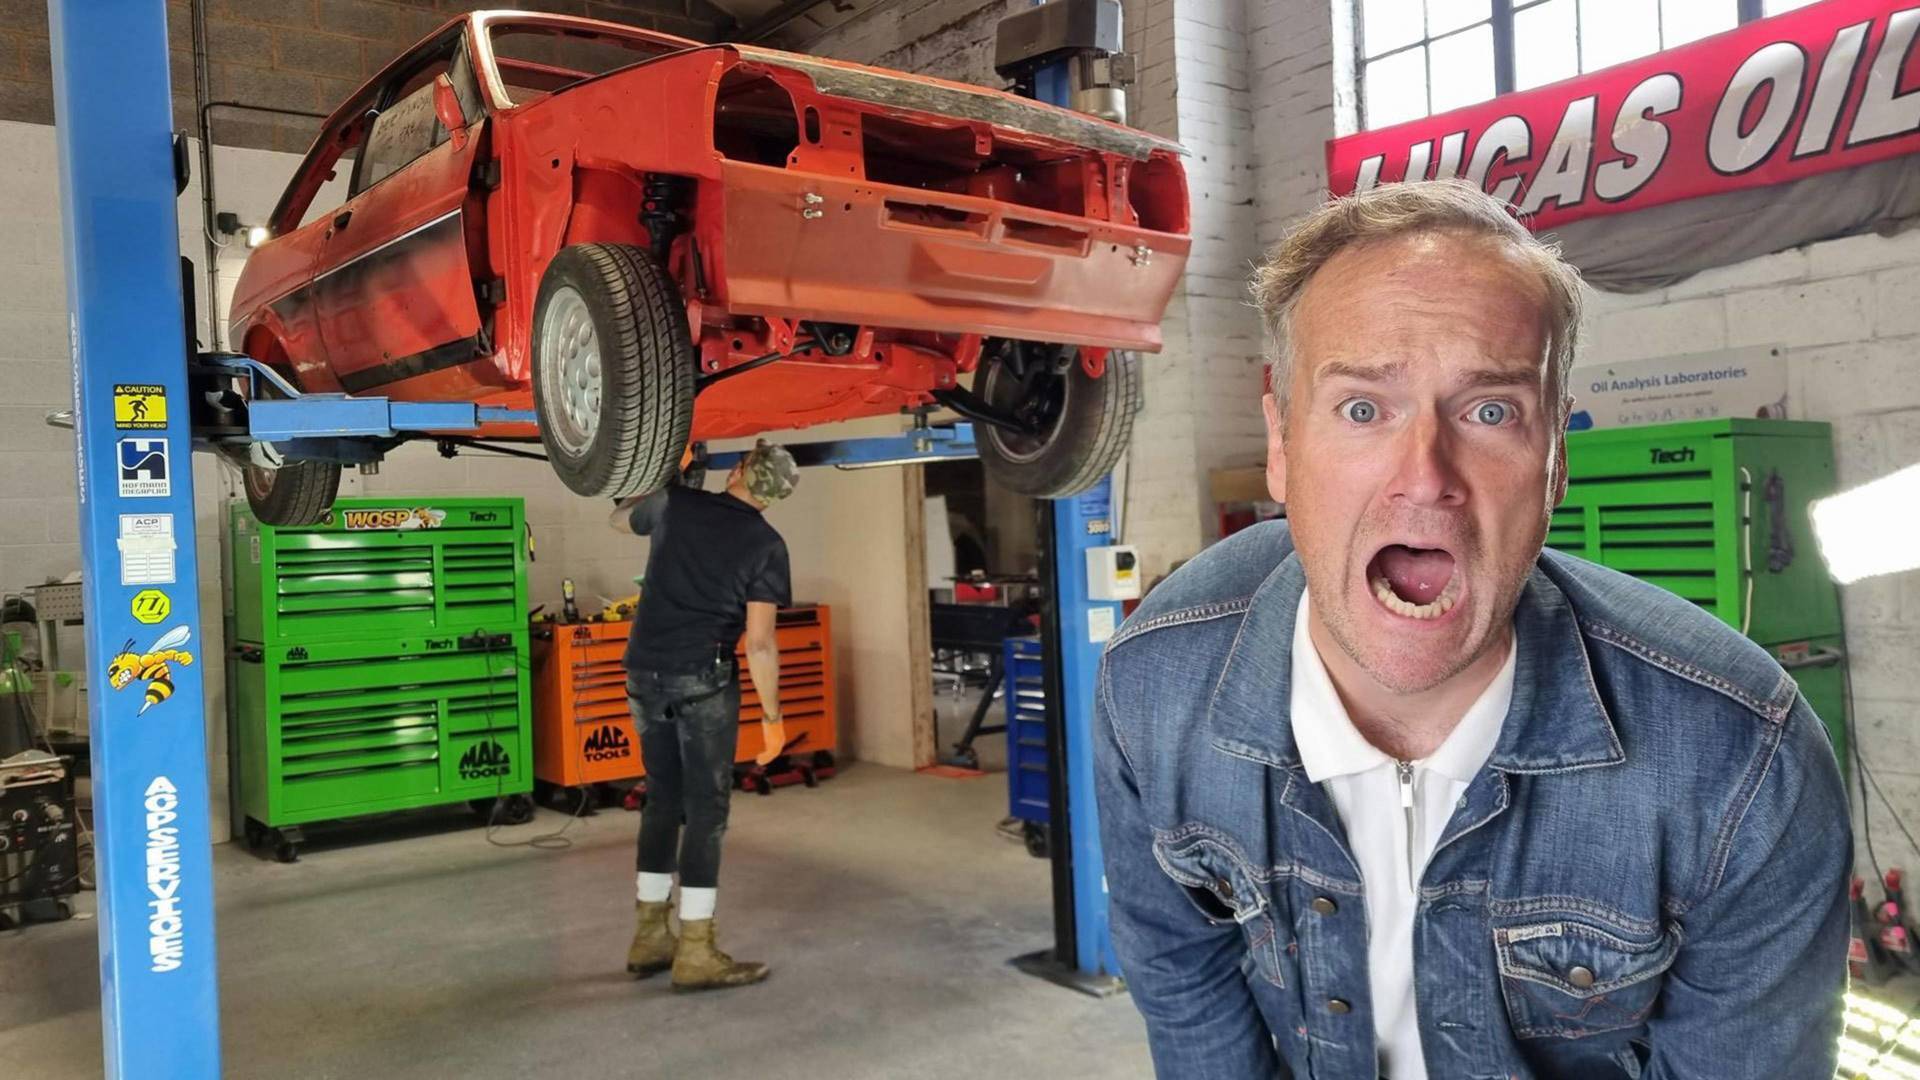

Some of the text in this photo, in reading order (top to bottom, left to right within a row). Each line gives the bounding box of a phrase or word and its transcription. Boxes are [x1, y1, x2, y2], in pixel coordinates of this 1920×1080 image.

[1707, 7, 1920, 177] OIL
[1591, 366, 1747, 394] Oil Analysis Laboratories
[123, 385, 163, 394] CAUTION
[1650, 446, 1695, 464] Tech
[135, 518, 159, 526] ACP
[345, 510, 410, 528] WOSP
[469, 511, 497, 522] Tech
[424, 639, 453, 650] Tech
[584, 725, 630, 752] MAC
[459, 740, 510, 769] MAC
[584, 748, 630, 763] TOOLS
[459, 766, 512, 780] TOOLS
